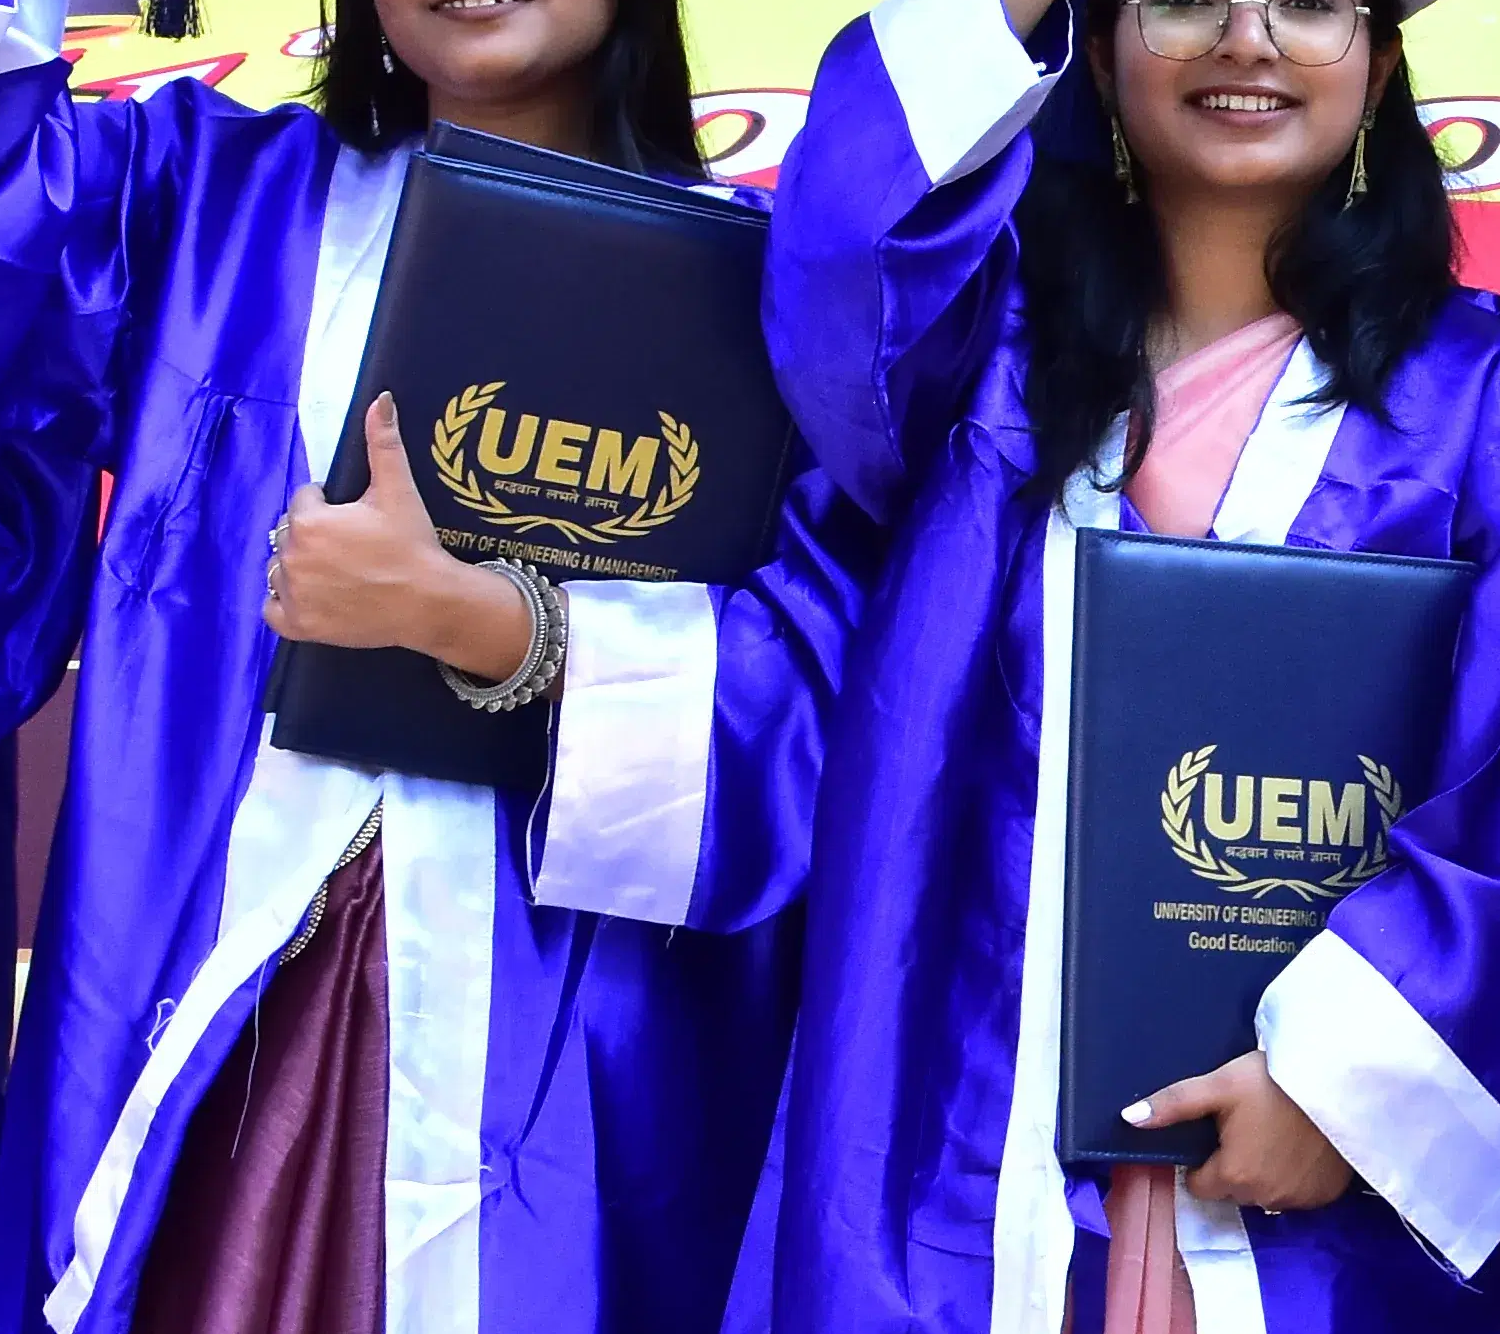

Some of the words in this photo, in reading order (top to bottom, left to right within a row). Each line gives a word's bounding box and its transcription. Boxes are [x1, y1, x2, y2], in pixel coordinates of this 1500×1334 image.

[477, 407, 660, 498] UEM
[435, 527, 475, 552] ERSITY
[477, 535, 496, 553] OF
[498, 539, 580, 569] ENGINEERING
[581, 554, 590, 571] &
[591, 556, 678, 582] MANAGEMENT
[1204, 773, 1366, 847] UEM
[1153, 901, 1219, 922] UNIVERSITY
[1223, 905, 1240, 923] OF
[1240, 906, 1317, 927] ENGINEERING
[1189, 931, 1225, 951] Good
